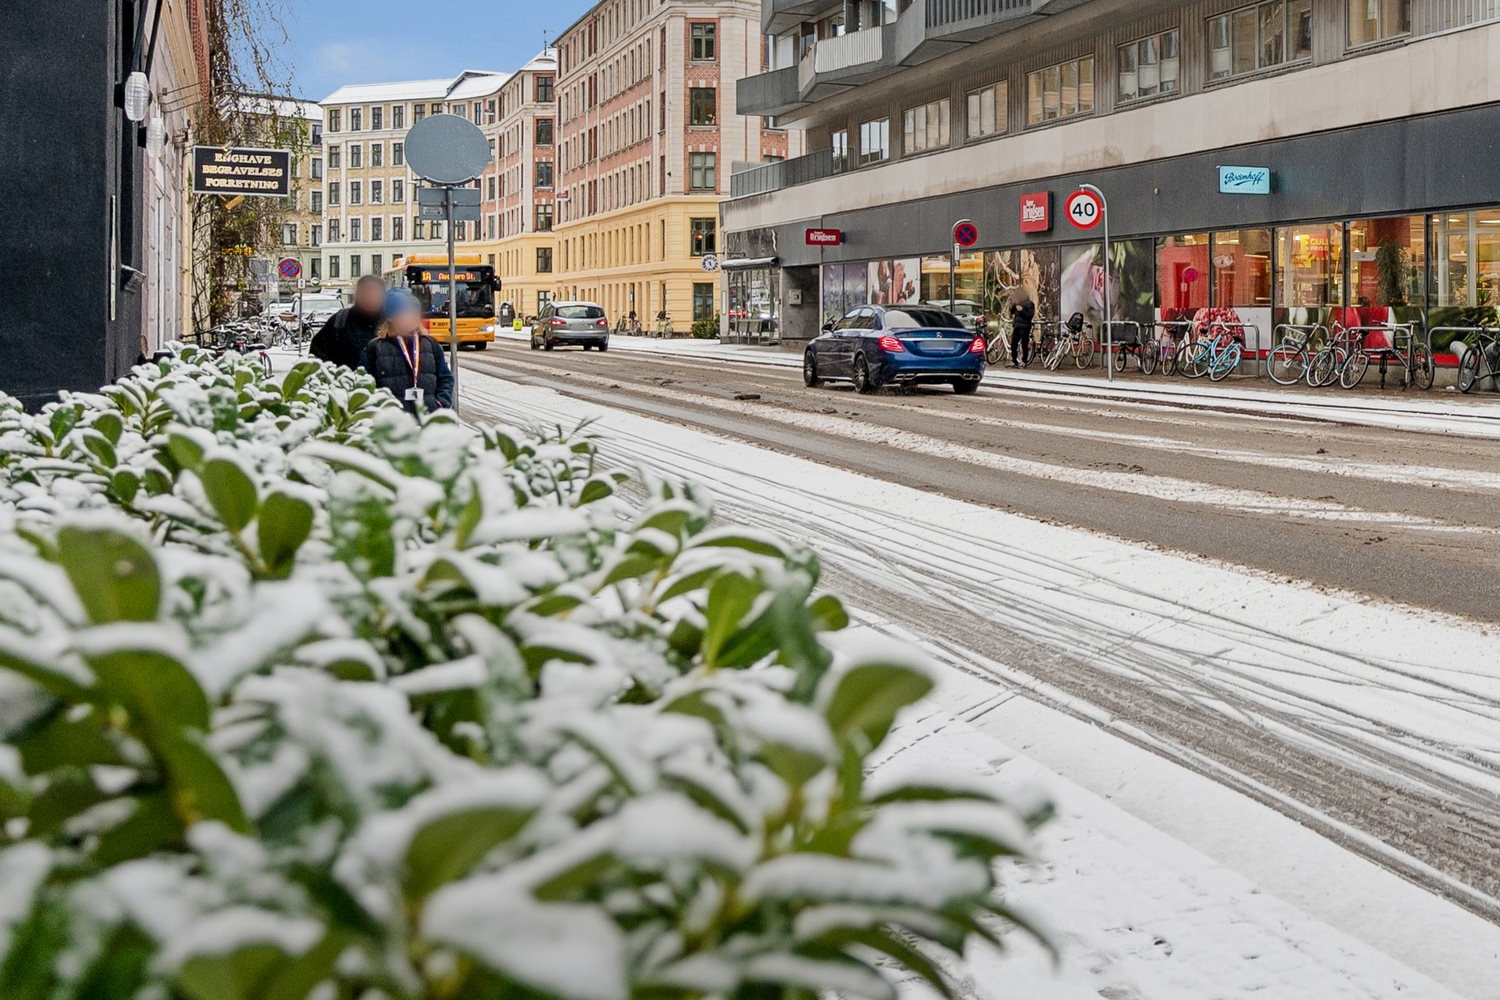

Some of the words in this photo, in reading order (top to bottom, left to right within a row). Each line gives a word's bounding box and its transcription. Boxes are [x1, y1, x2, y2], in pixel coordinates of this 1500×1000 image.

[214, 153, 272, 164] ENGHAVE
[202, 165, 283, 177] BEGRAVELSES
[205, 178, 279, 189] FORRETNING
[1072, 202, 1095, 217] 40
